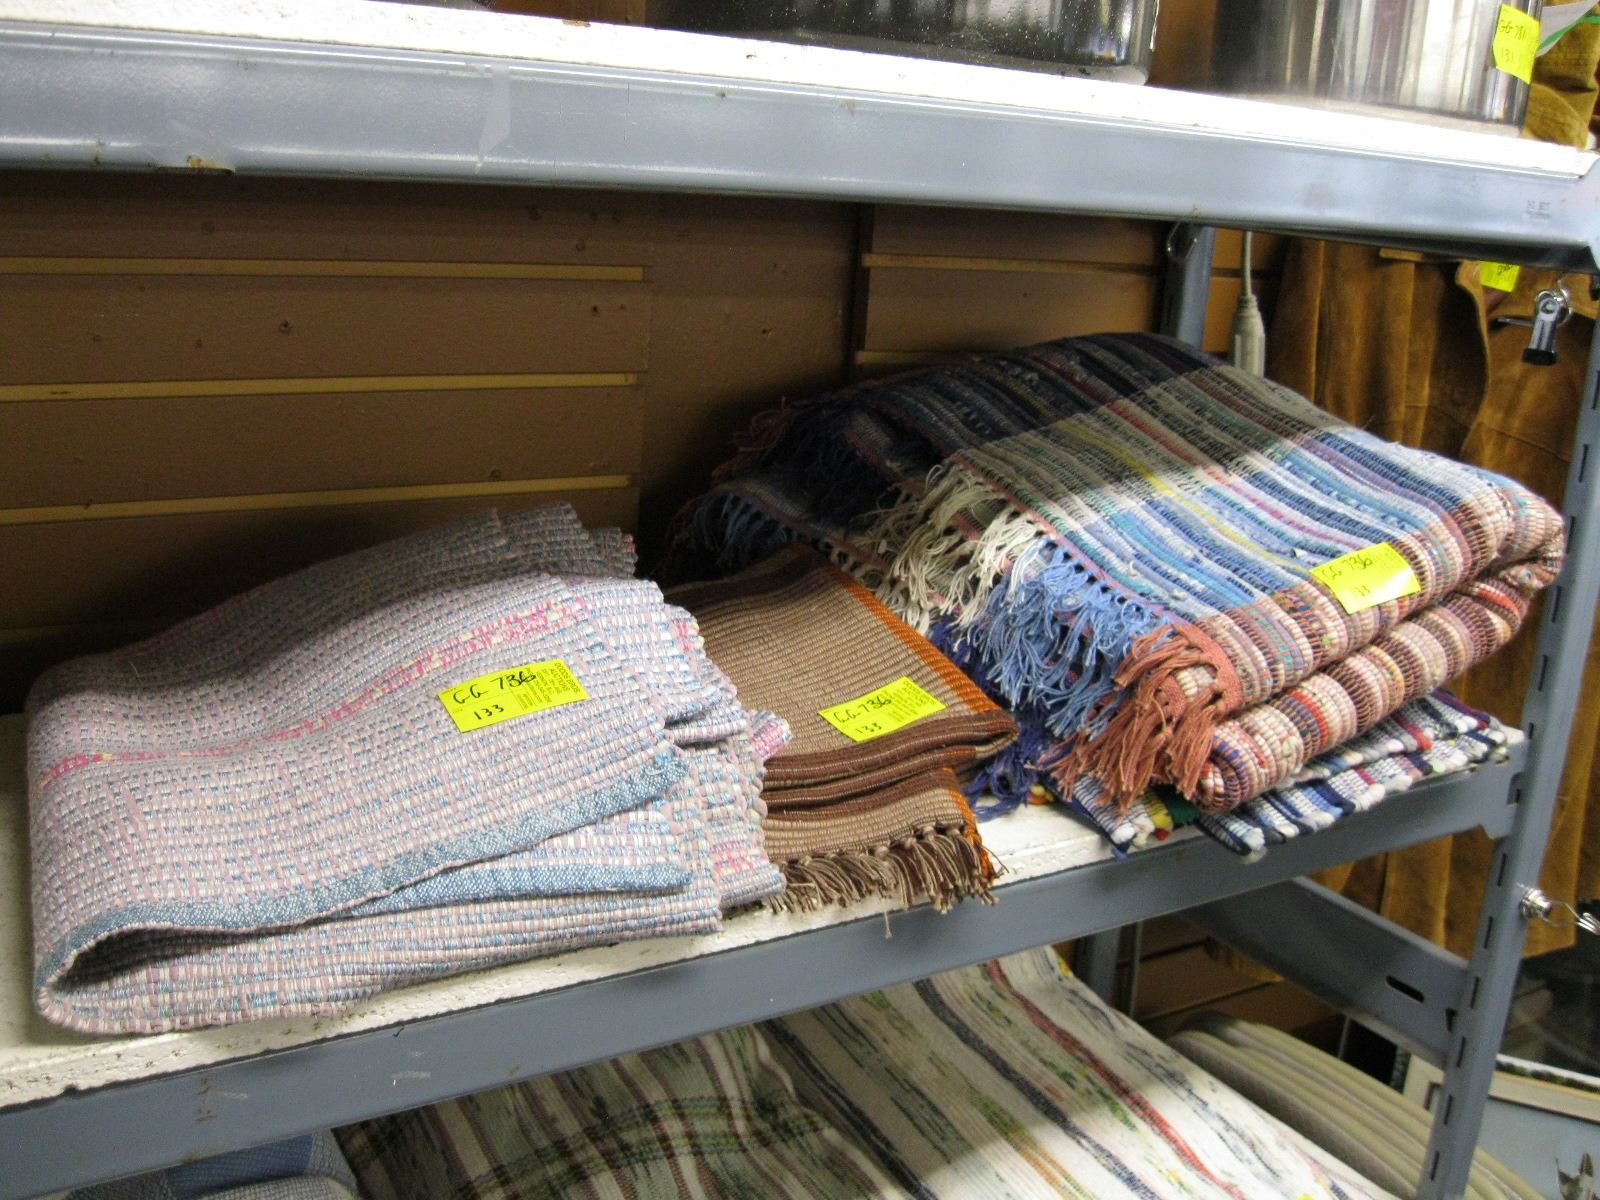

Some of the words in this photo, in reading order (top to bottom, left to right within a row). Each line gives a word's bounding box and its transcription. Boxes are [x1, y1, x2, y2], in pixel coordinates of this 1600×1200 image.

[490, 671, 537, 690] 736
[473, 704, 505, 720] 133
[859, 695, 892, 713] 736
[855, 723, 882, 734] 133
